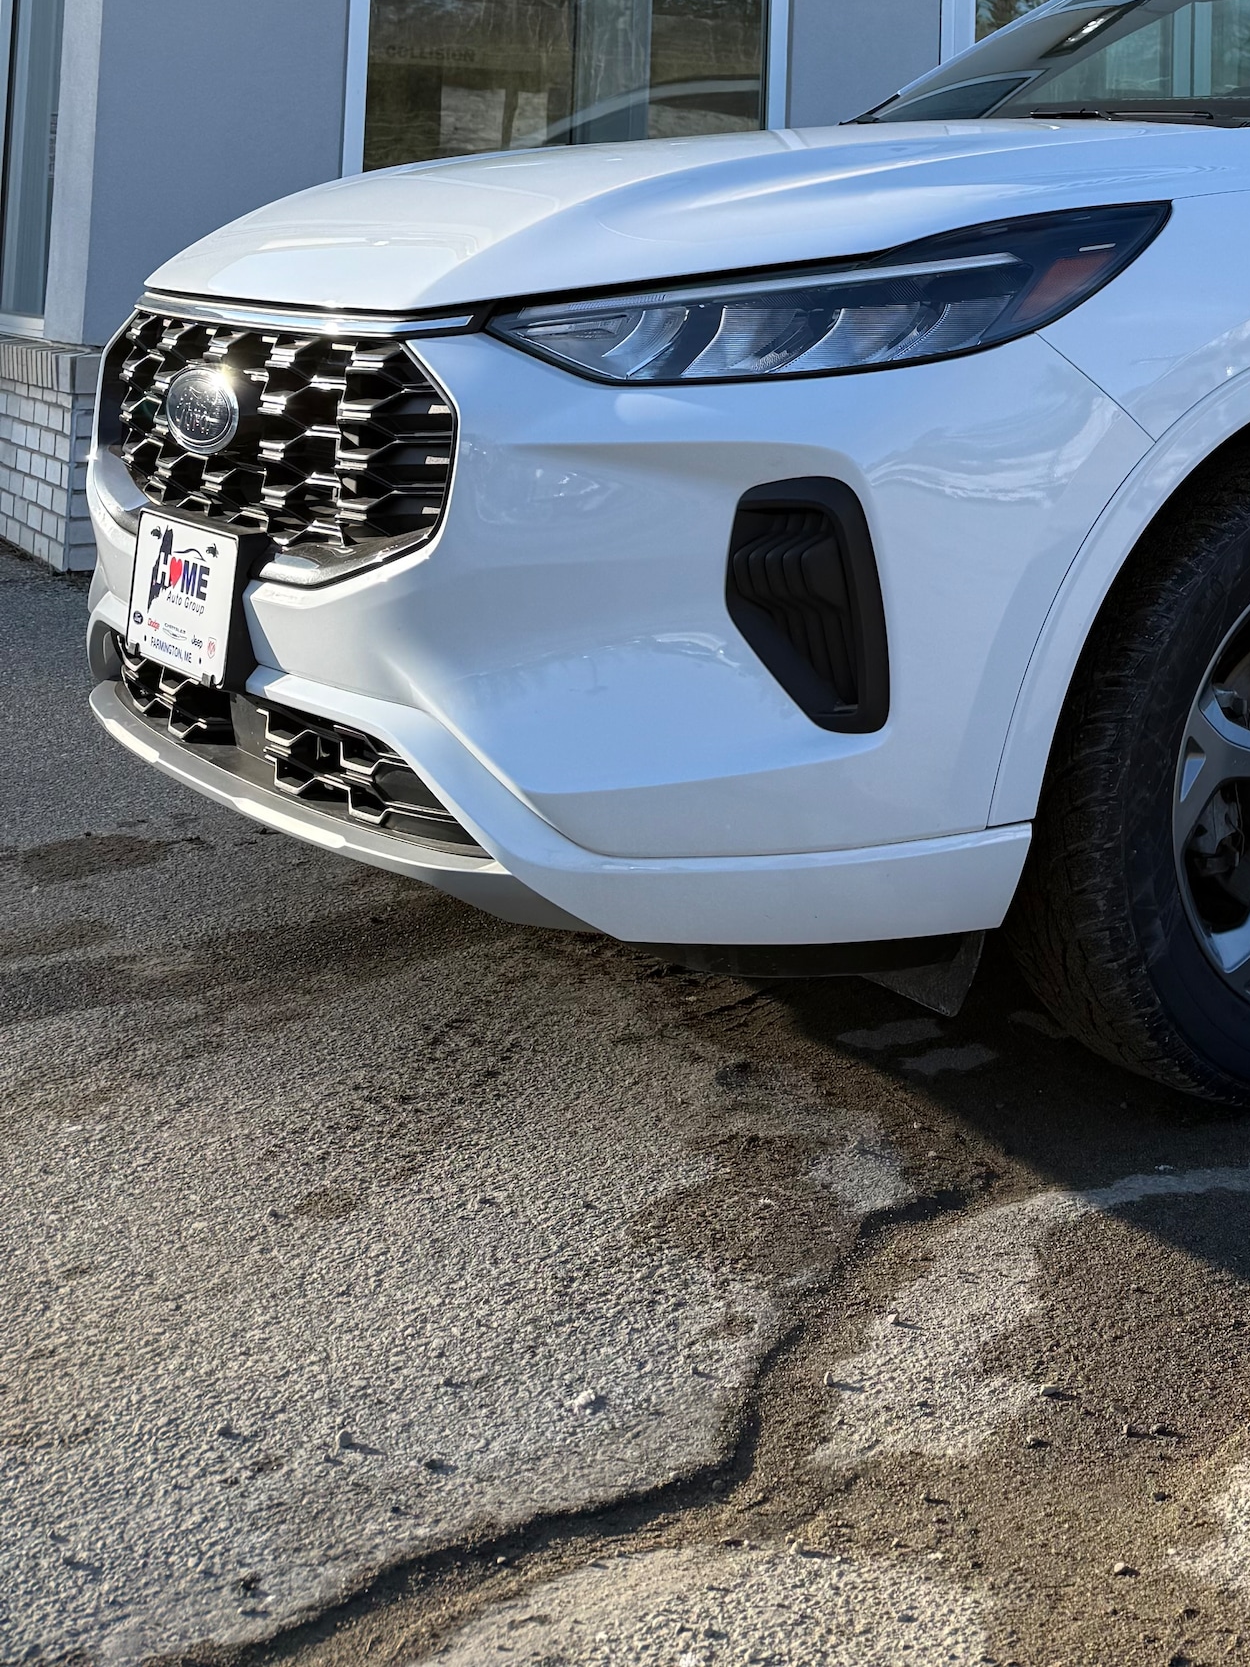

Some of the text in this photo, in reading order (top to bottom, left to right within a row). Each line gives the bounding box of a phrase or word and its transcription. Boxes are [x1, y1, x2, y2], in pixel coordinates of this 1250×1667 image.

[166, 590, 205, 616] Auto Group
[184, 650, 192, 663] ME
